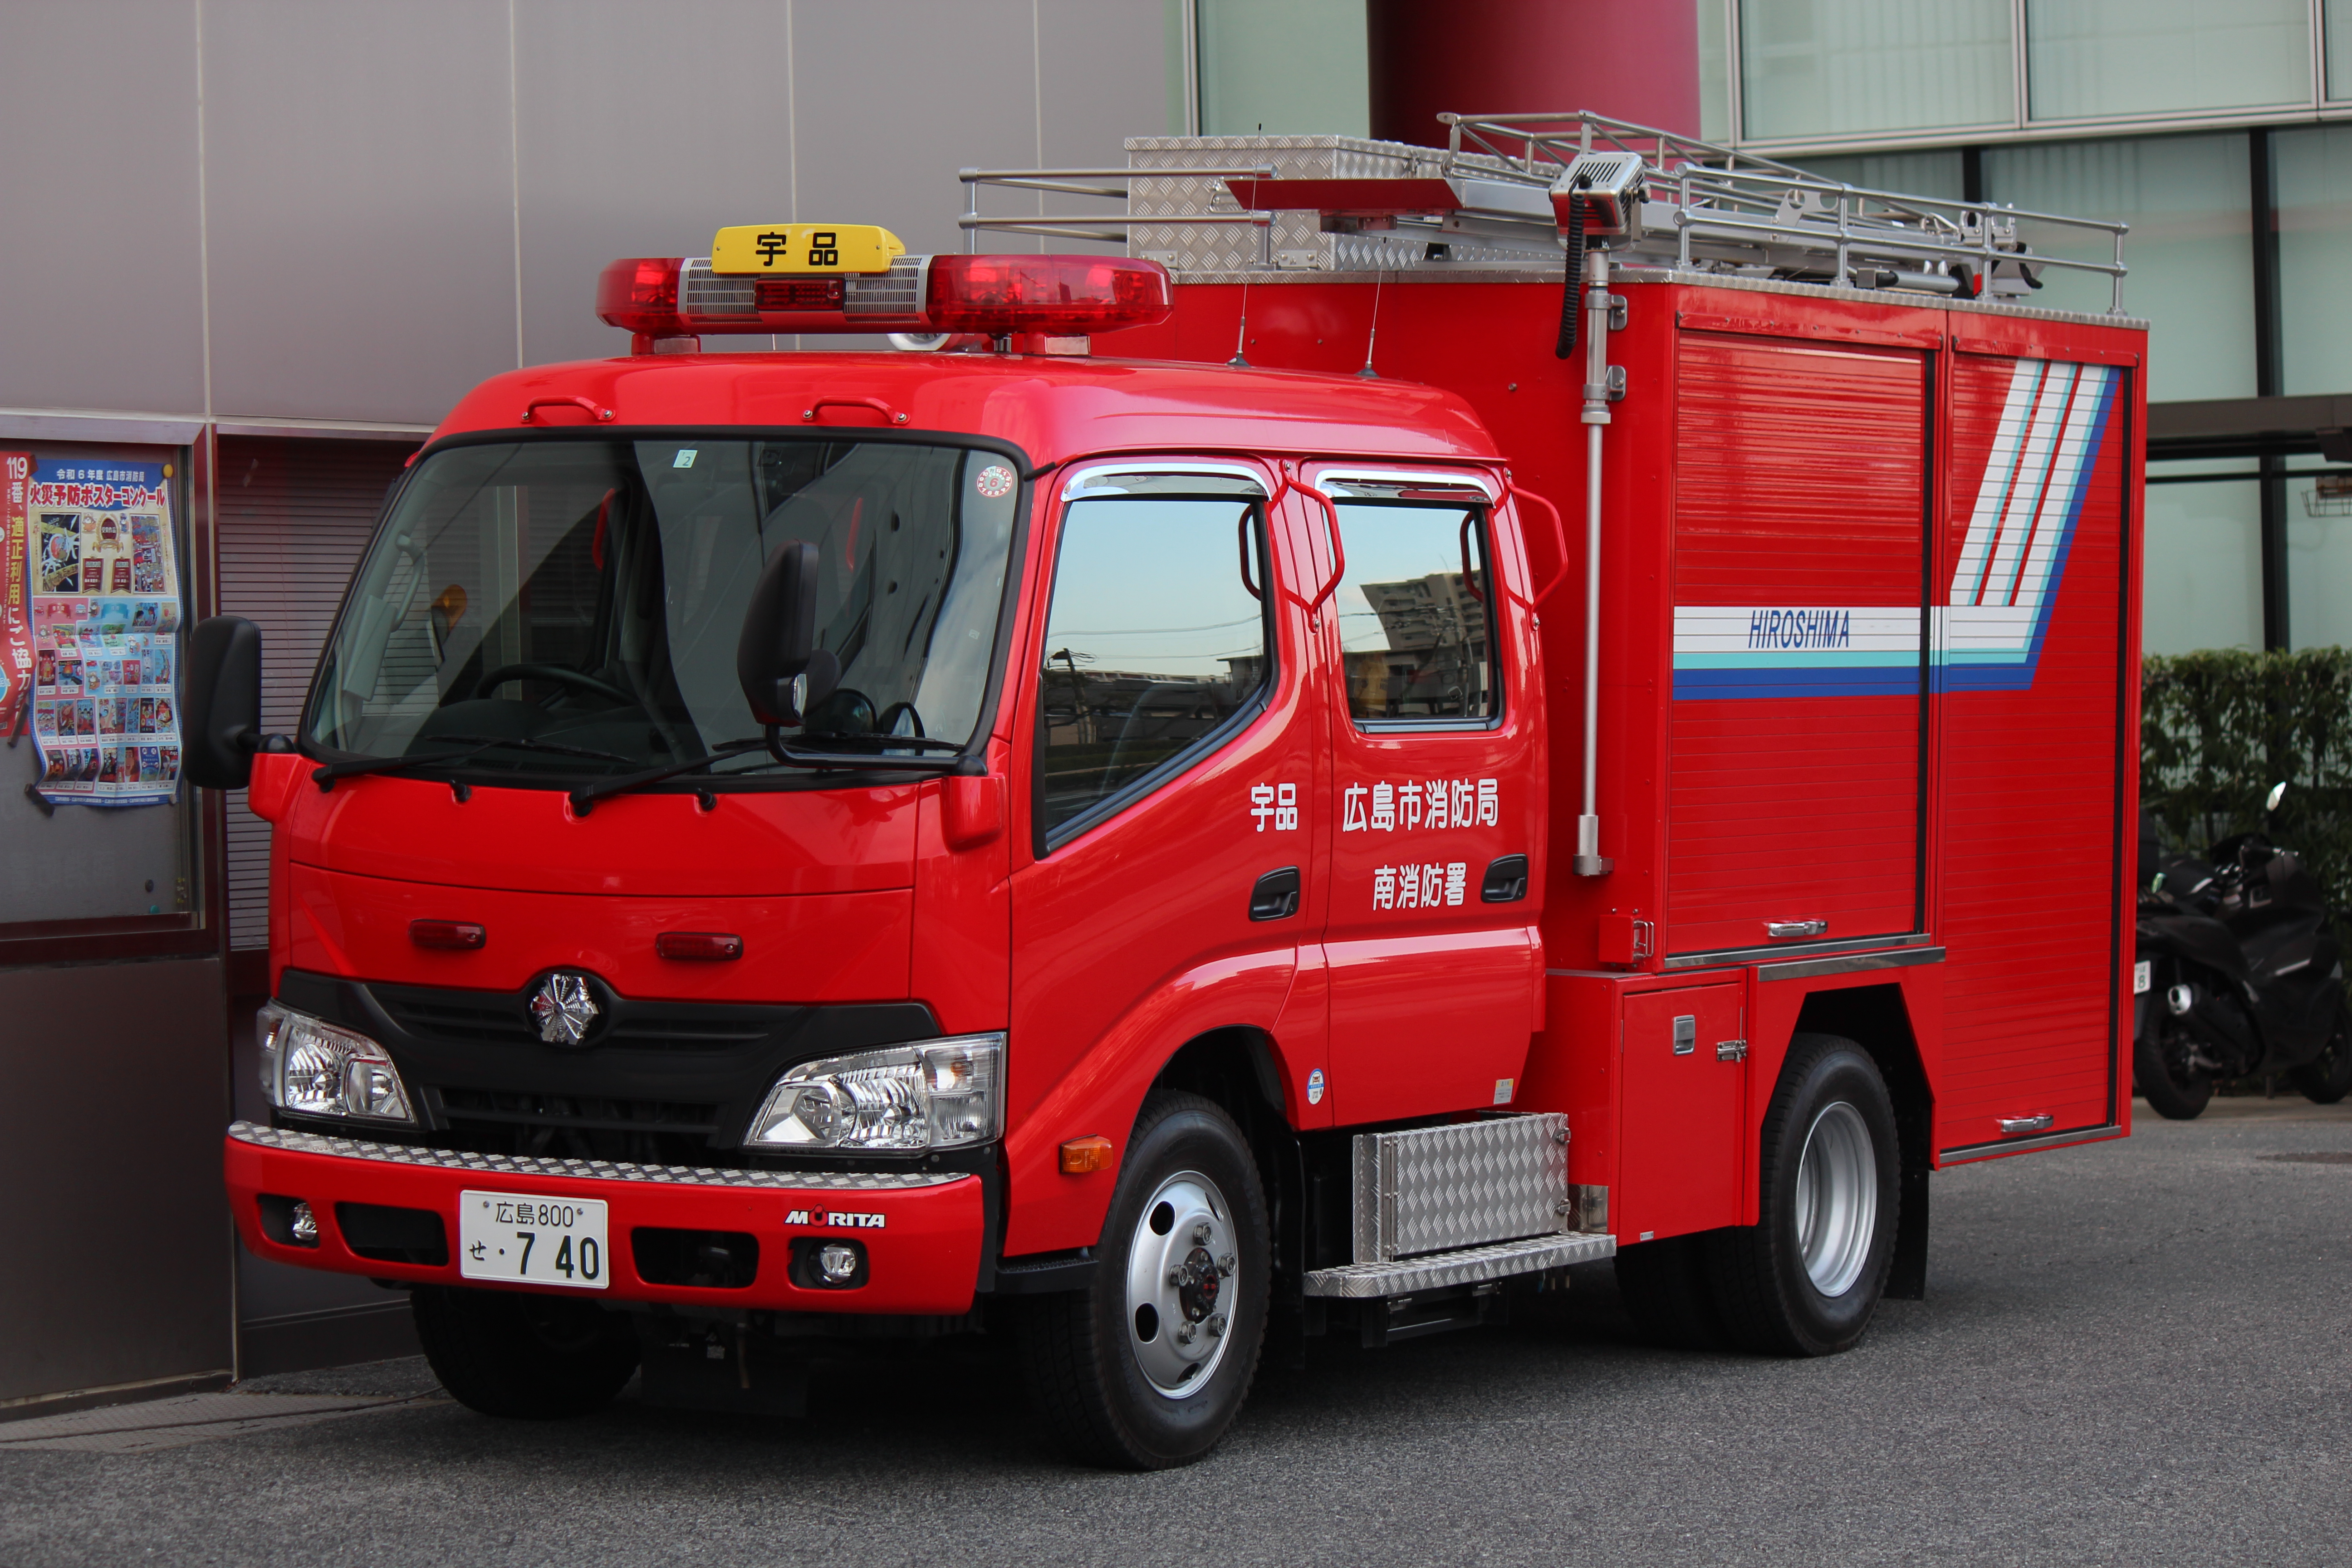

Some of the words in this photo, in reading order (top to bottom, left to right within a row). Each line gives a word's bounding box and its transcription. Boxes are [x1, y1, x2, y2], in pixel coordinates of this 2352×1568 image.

[682, 456, 691, 466] 2
[106, 470, 145, 483] 広島市消防局
[989, 478, 999, 487] 6
[29, 483, 166, 509] 火災予防ポスターコンクール
[1748, 610, 1849, 648] HIROSHIMA
[1250, 782, 1298, 833] 宇品
[1342, 777, 1499, 833] 広島市消防局
[1372, 862, 1467, 911] 南消防署
[784, 1205, 885, 1228] MORITA
[469, 1239, 487, 1261] せ
